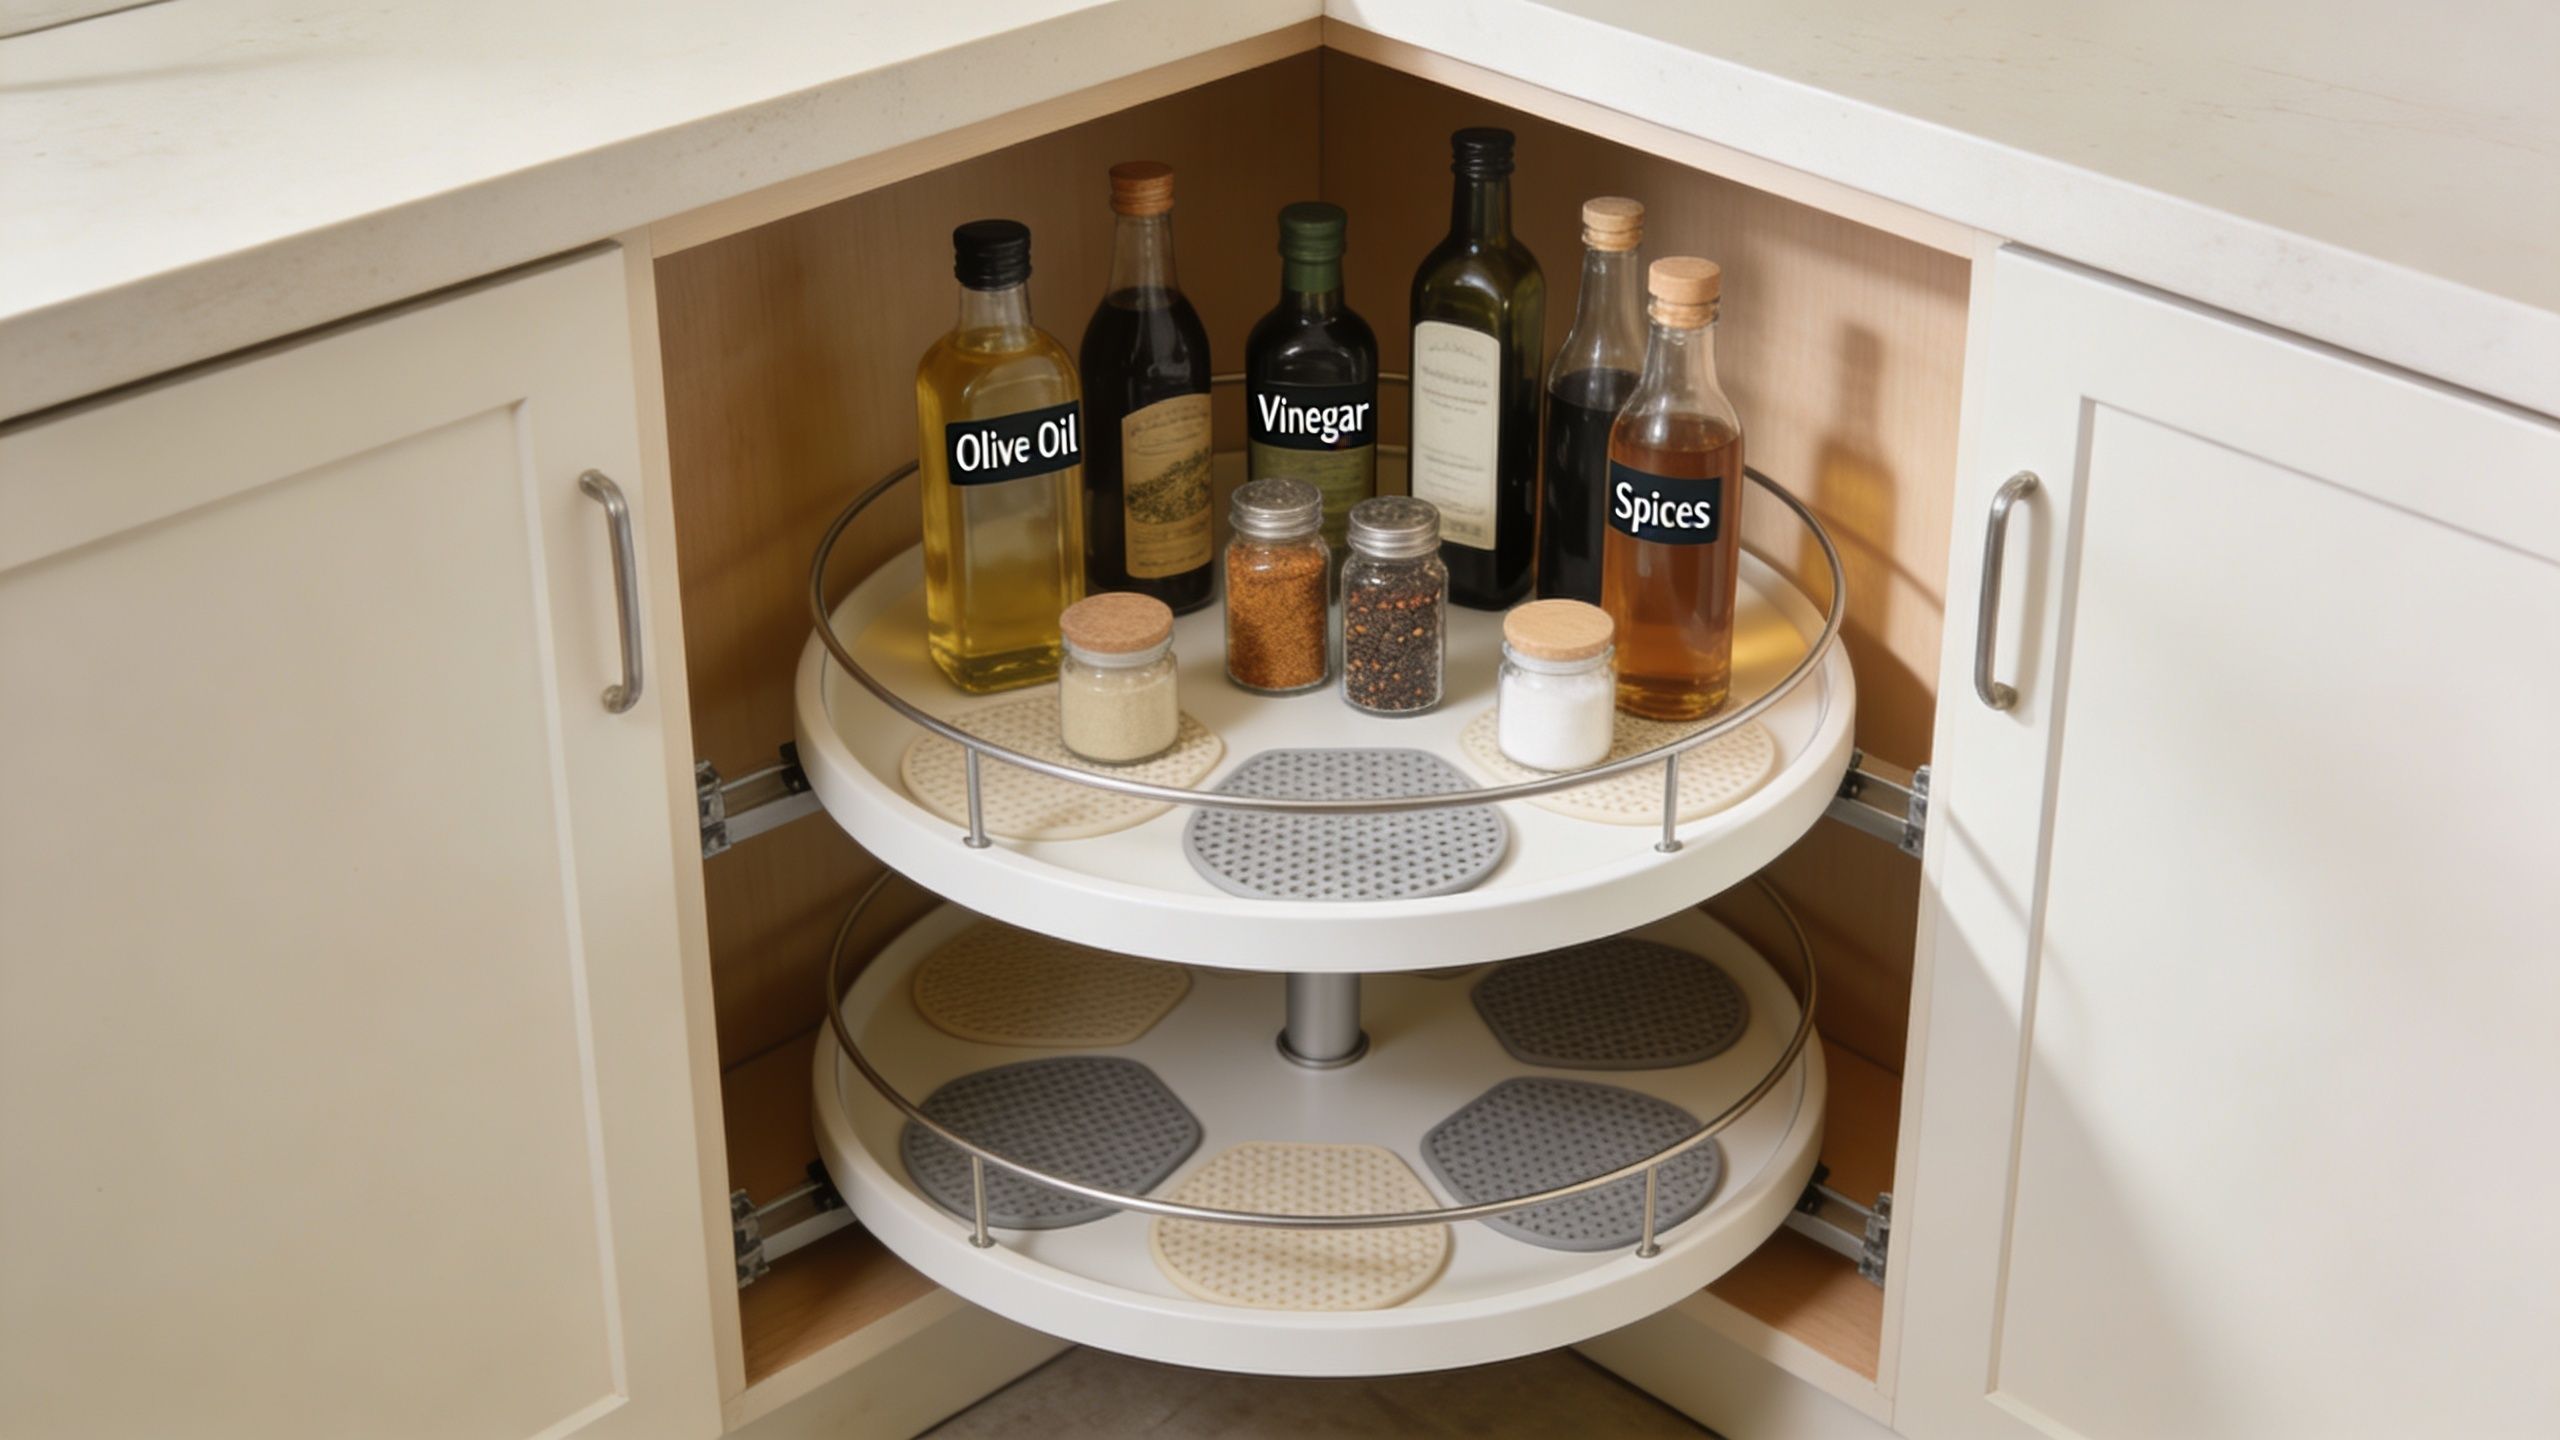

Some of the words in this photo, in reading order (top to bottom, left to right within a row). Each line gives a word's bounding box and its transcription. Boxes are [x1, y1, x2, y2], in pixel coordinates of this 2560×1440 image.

[956, 430, 1030, 472] Olive
[1038, 413, 1079, 458] Oil
[1257, 394, 1370, 444] Vinegar
[1615, 481, 1711, 533] Spices
